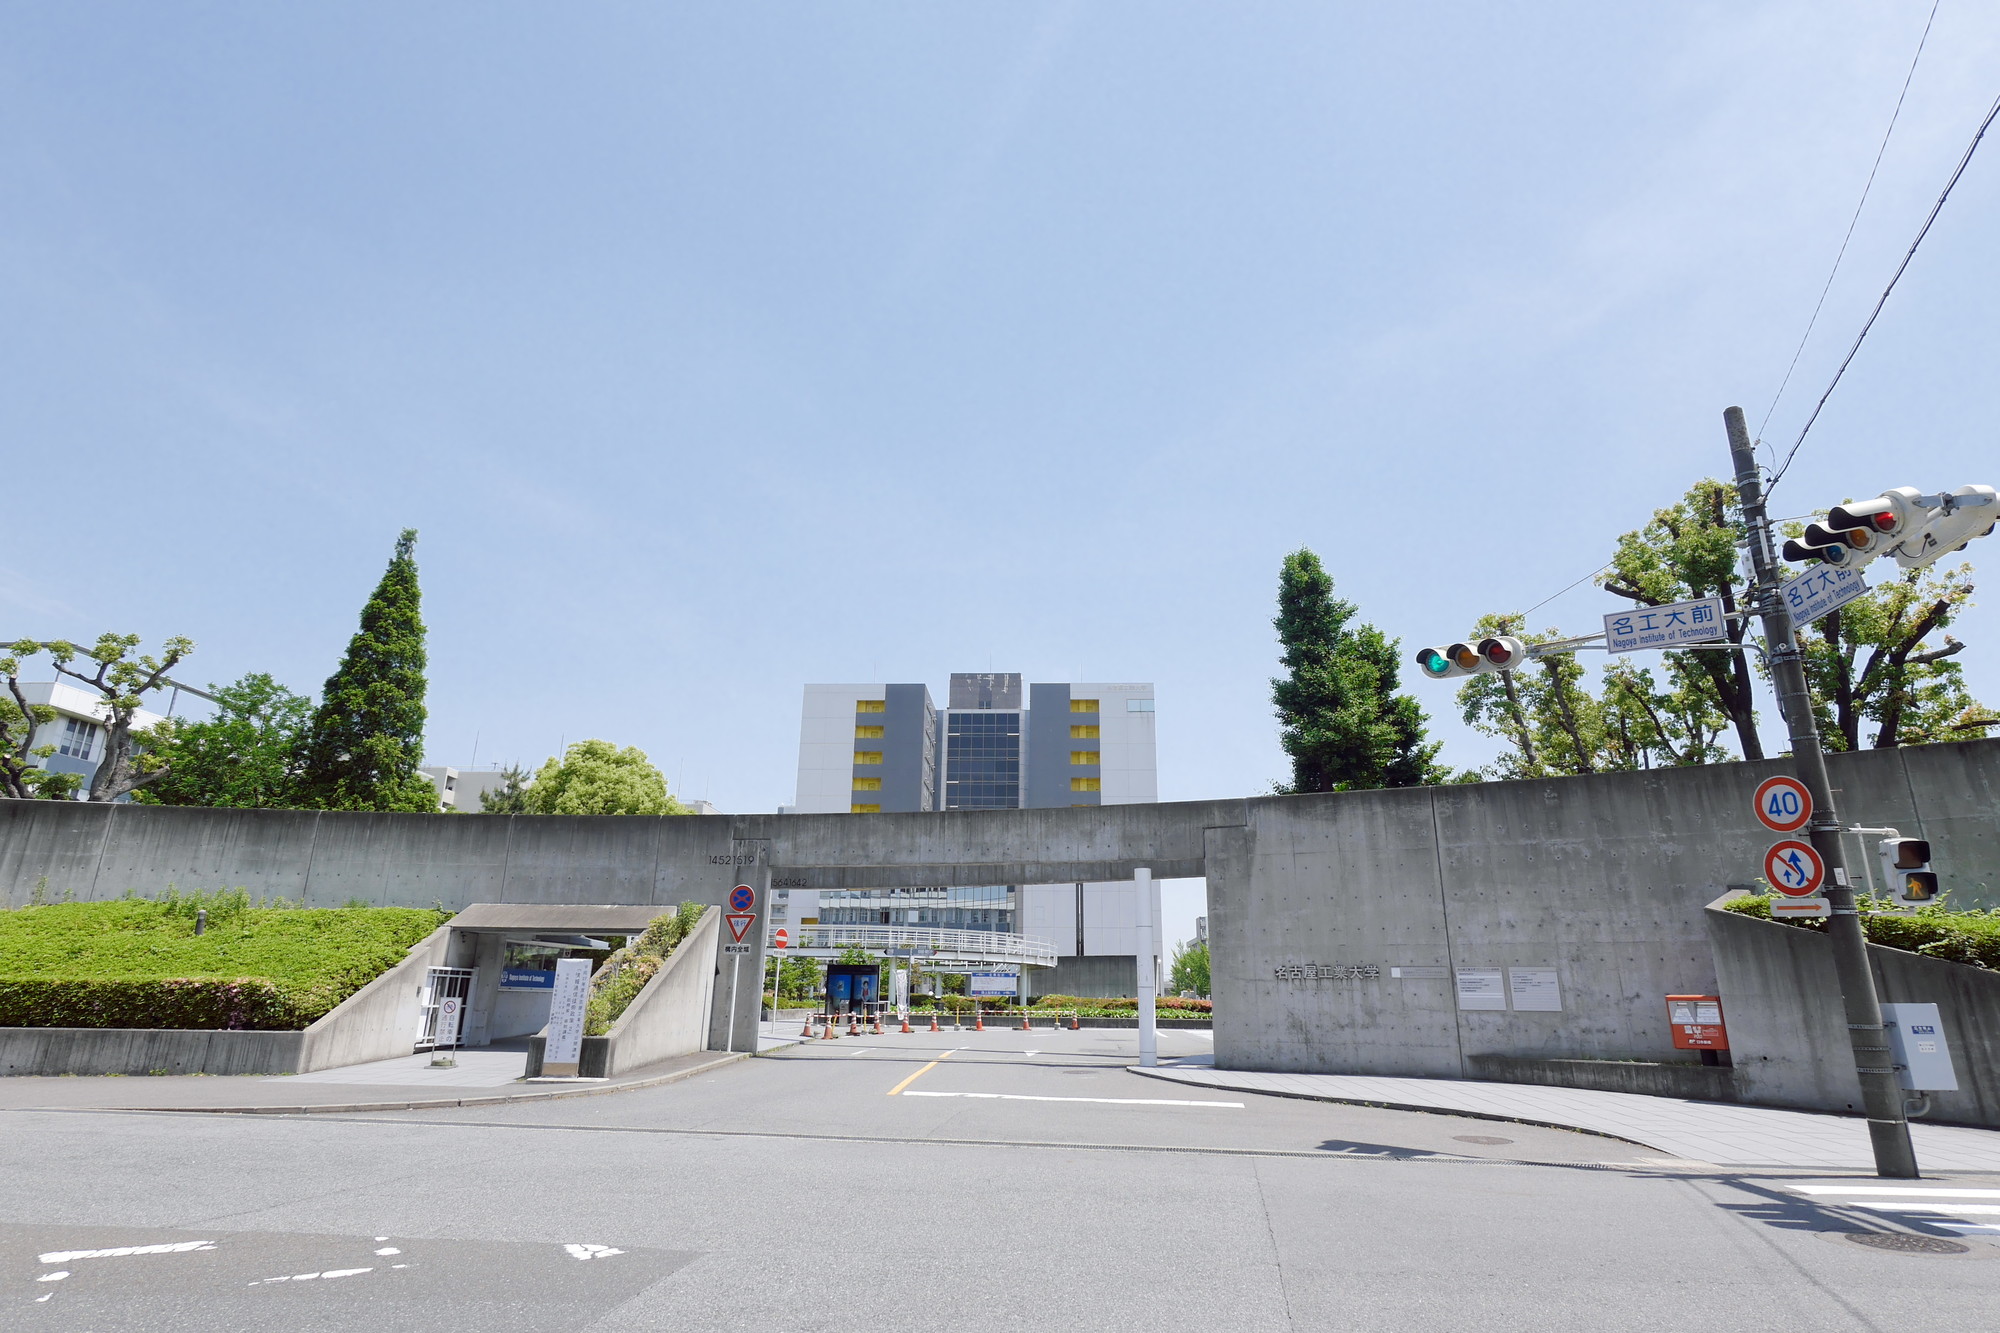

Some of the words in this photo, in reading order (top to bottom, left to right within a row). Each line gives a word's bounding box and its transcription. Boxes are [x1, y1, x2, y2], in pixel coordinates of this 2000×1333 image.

[1787, 569, 1852, 607] 名工大前
[1793, 608, 1811, 621] Nagoya
[1809, 597, 1828, 613] Institute
[1827, 593, 1834, 603] of
[1832, 580, 1860, 599] Technology
[1612, 604, 1714, 635] 名工大前
[1613, 638, 1637, 648] Nagoya
[1639, 632, 1665, 644] Institute
[1668, 630, 1676, 639] of
[1678, 625, 1718, 638] Technology
[1768, 791, 1799, 816] 40
[708, 855, 755, 865] 14521519
[733, 919, 746, 927] 徐行
[1275, 965, 1379, 980] 名古屋工業大学
